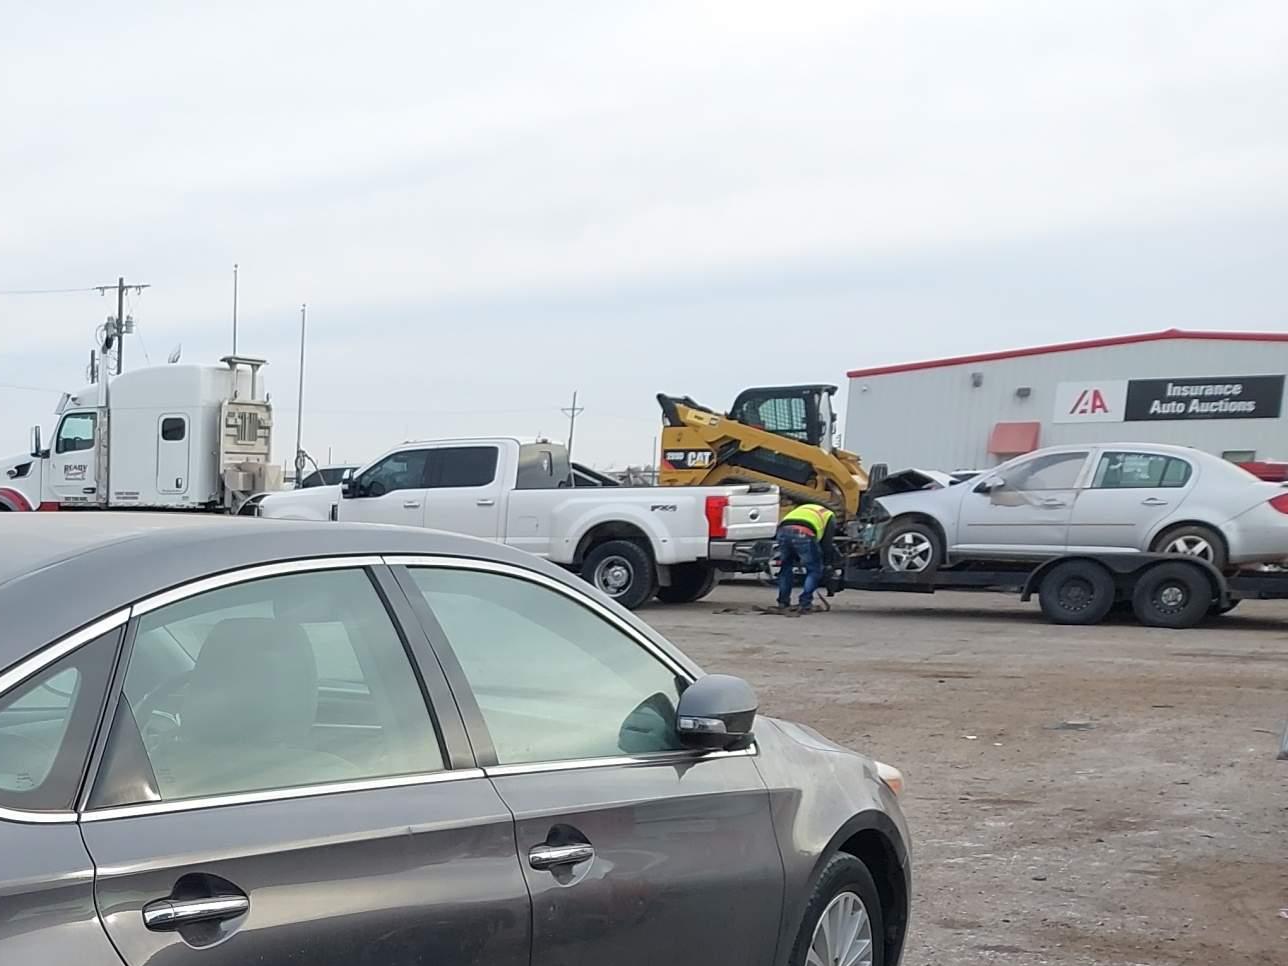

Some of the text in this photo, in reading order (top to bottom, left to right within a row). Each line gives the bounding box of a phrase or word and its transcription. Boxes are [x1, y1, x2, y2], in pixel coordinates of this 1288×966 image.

[1166, 383, 1243, 397] Insurance
[1149, 398, 1257, 414] Auto Auctions
[687, 451, 712, 467] CAT
